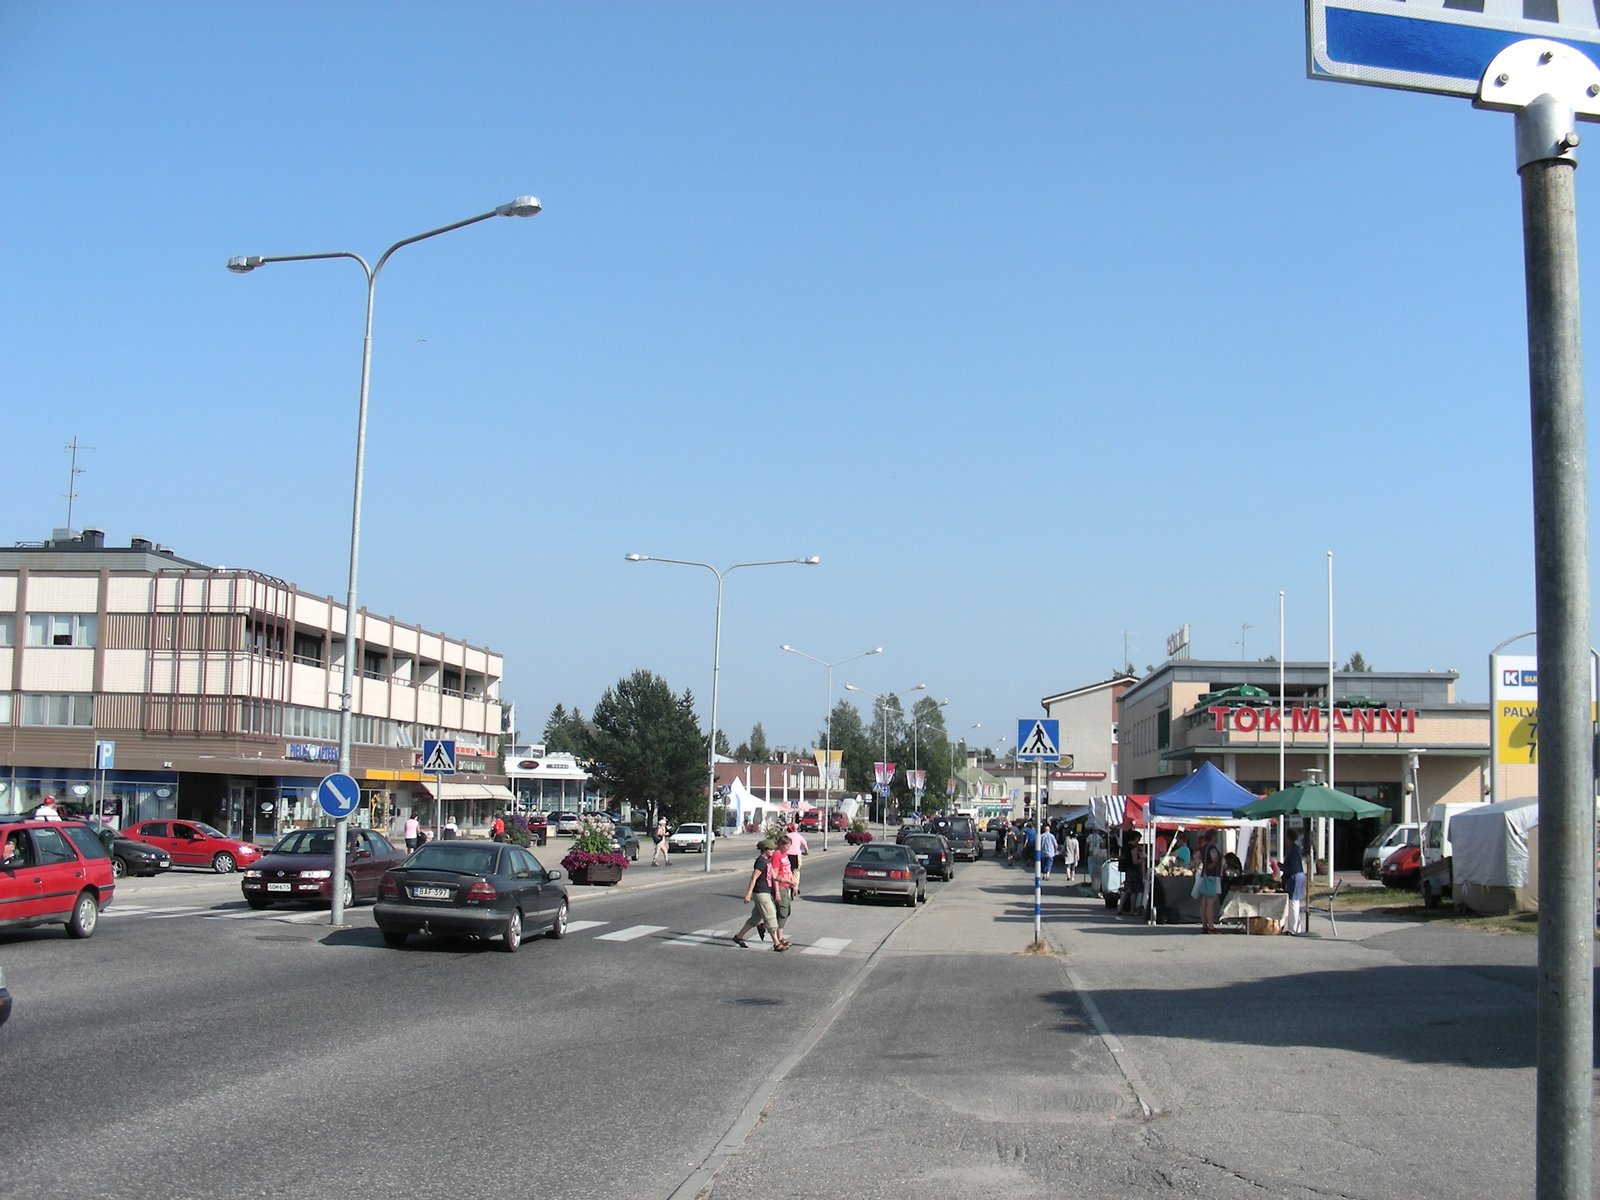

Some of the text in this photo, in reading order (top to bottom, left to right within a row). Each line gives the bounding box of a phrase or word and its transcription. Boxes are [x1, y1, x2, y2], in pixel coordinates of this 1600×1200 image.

[1504, 671, 1518, 685] K
[1208, 706, 1415, 734] TOKMANNI
[1503, 707, 1538, 718] PALV
[102, 743, 113, 767] P
